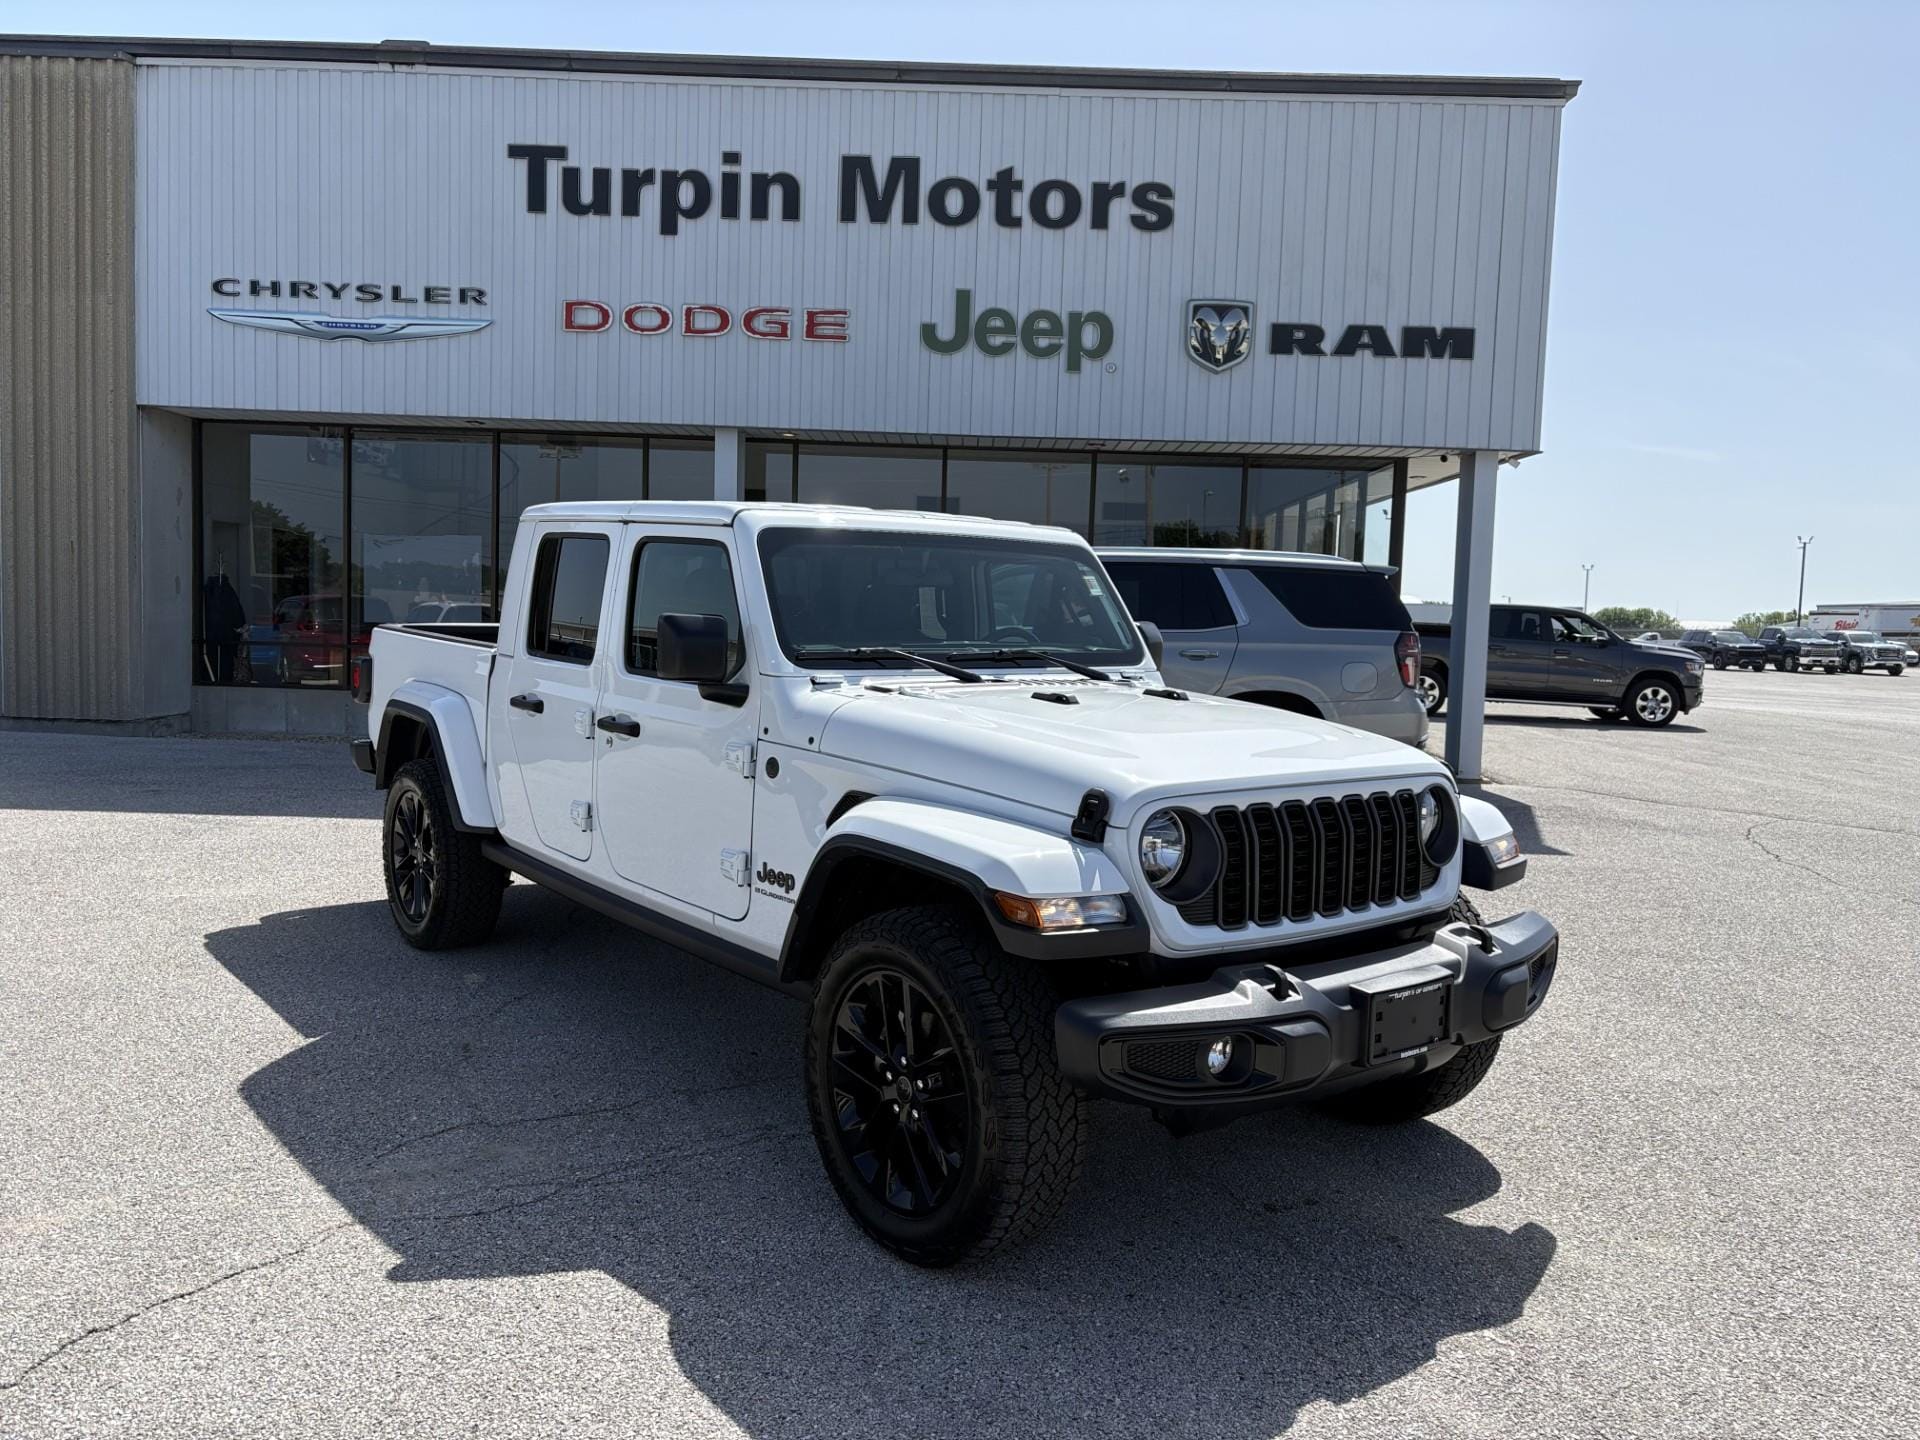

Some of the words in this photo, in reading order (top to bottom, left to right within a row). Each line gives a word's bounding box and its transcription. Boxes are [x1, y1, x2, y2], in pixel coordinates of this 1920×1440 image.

[508, 144, 802, 236] Turpin
[840, 155, 1174, 232] Motors
[211, 277, 489, 305] CHRYSLER
[563, 300, 852, 343] DODGE
[920, 289, 1114, 372] Jeep
[1269, 322, 1477, 361] RAM
[757, 861, 795, 894] Jeep
